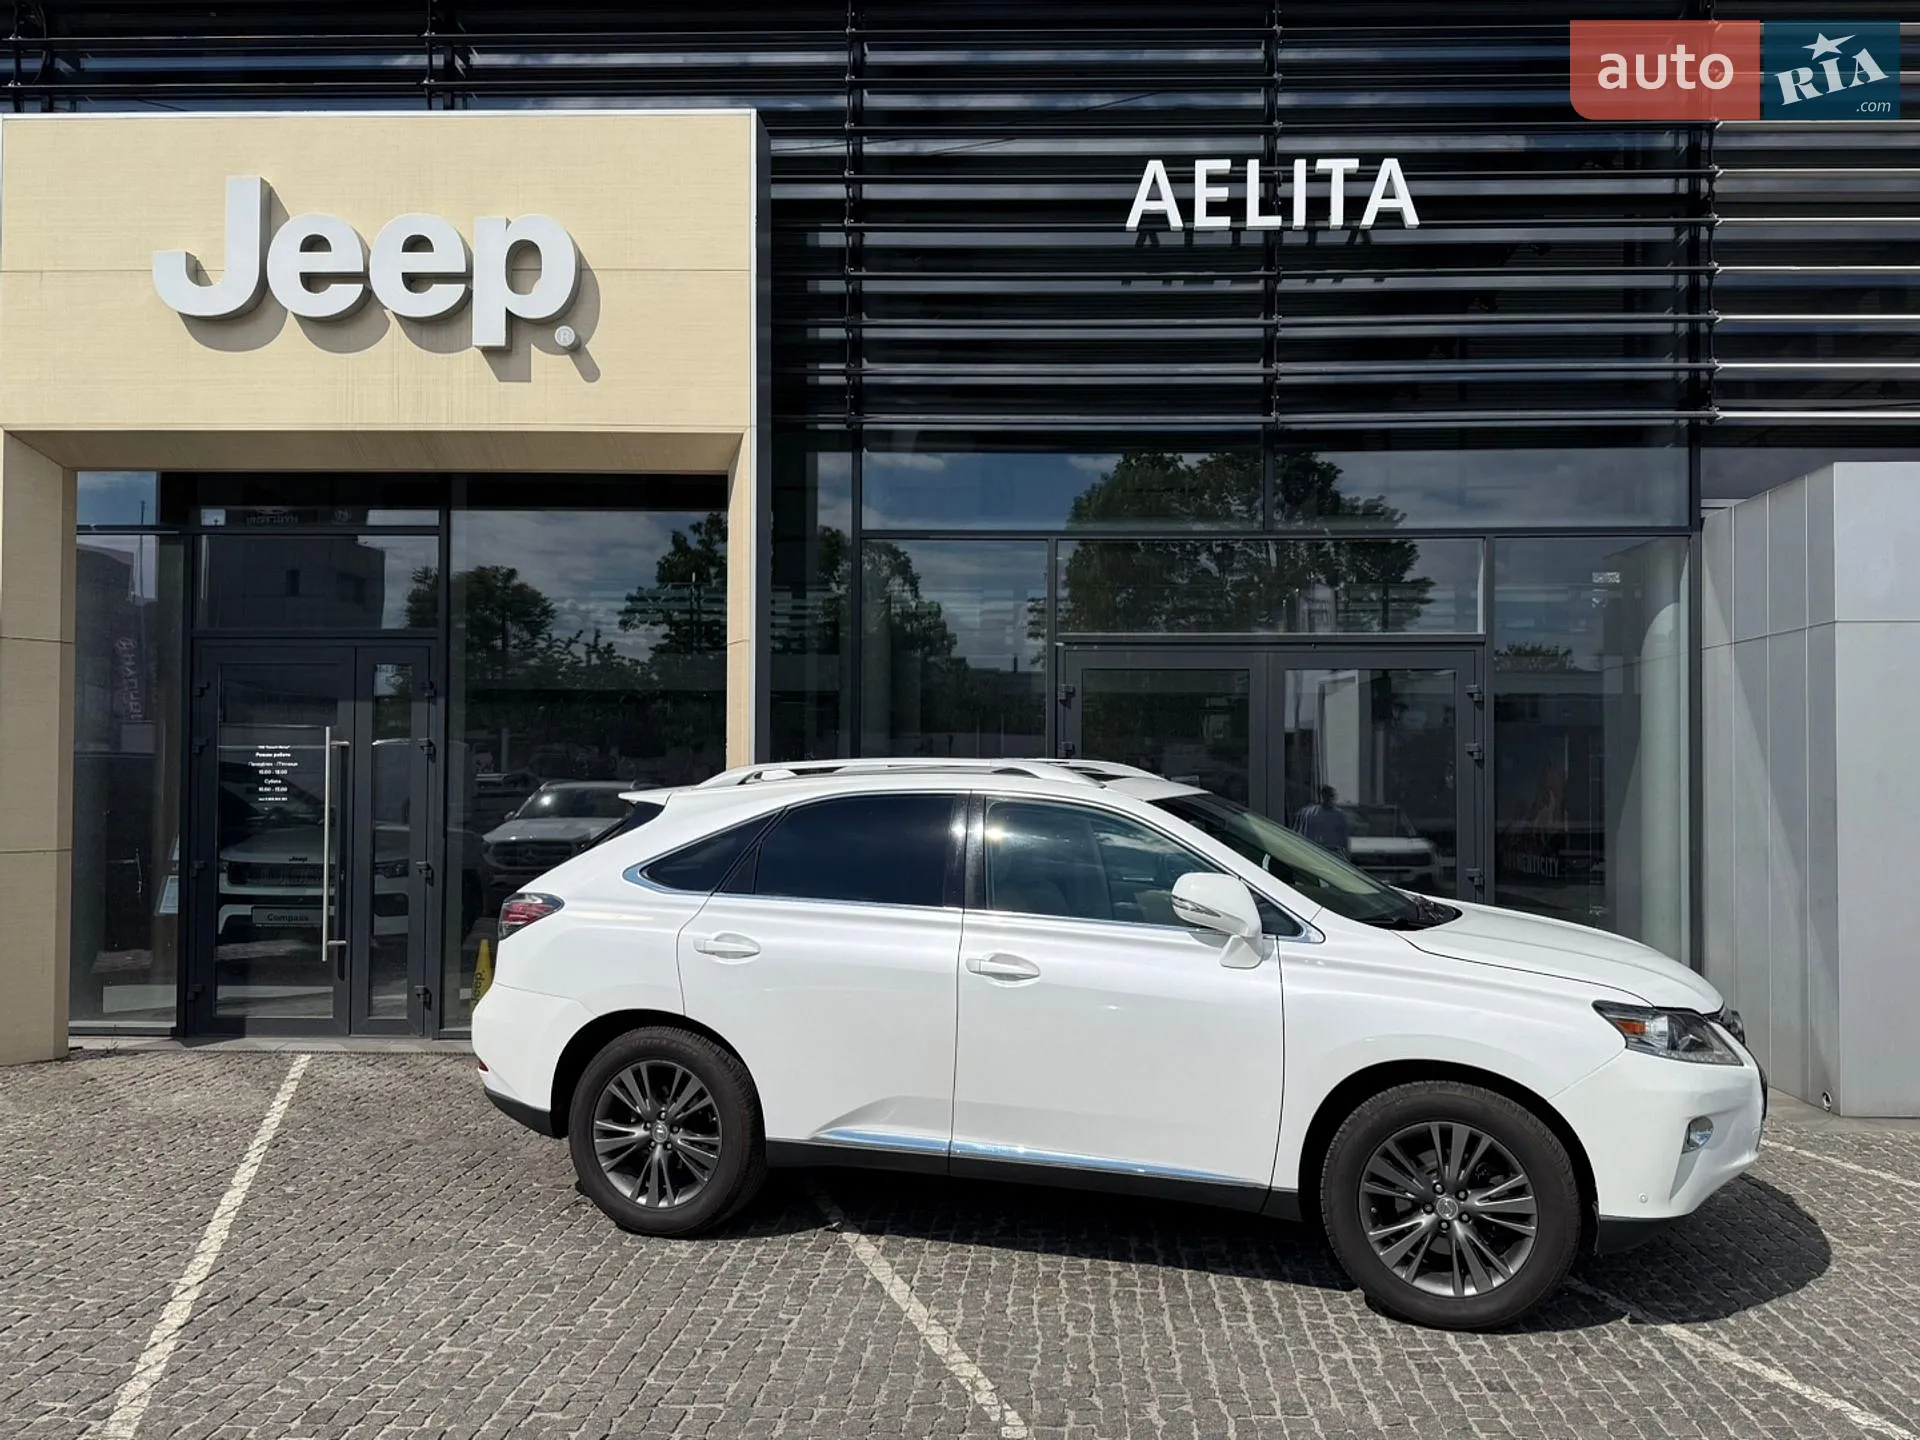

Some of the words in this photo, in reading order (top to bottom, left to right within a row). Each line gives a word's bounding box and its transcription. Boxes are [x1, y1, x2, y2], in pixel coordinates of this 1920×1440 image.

[1125, 157, 1420, 232] AELITA
[151, 174, 579, 349] Jeep
[267, 913, 310, 923] Compass
